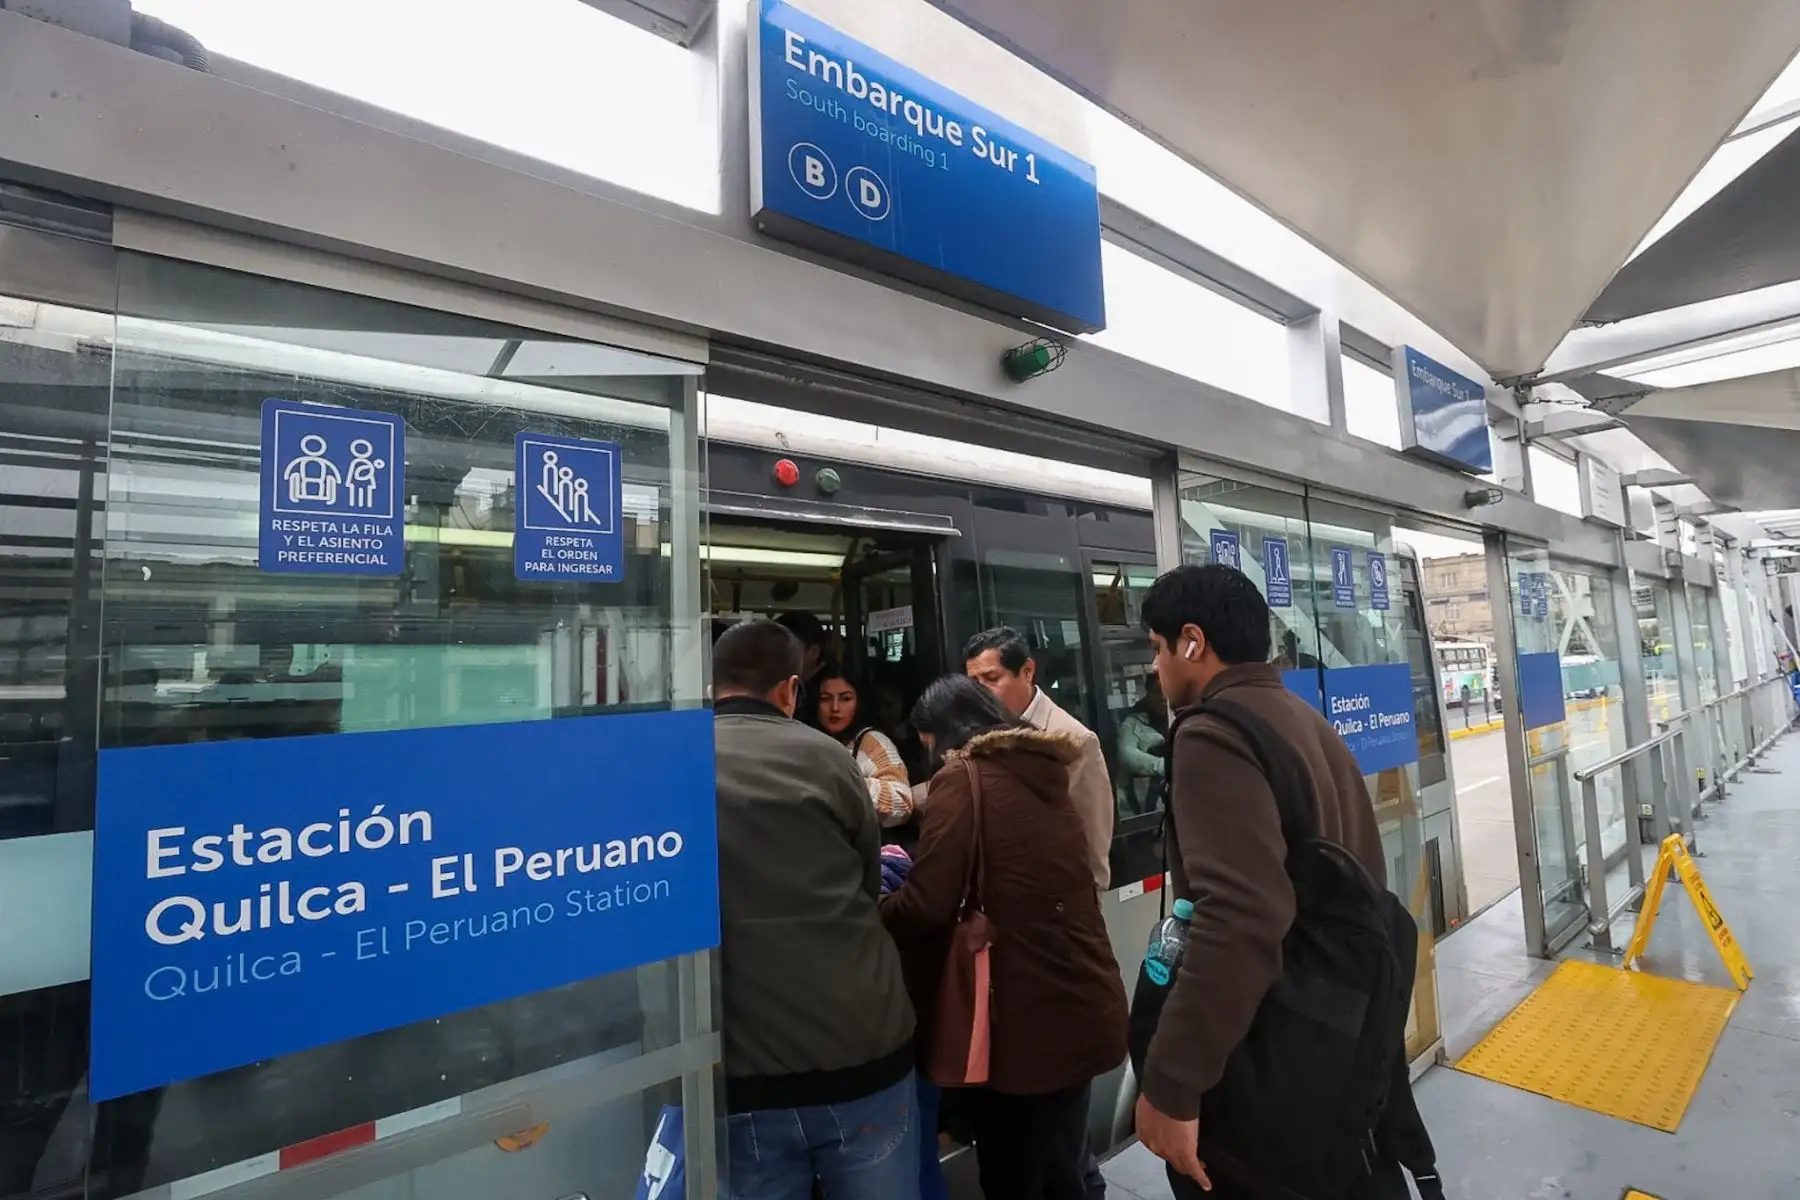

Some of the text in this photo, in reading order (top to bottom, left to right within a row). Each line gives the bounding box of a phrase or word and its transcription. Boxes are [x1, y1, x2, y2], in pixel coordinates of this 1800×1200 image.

[784, 29, 1040, 185] Embarque Sur 1
[786, 78, 950, 171] South boarding 1
[804, 155, 881, 209] B D
[272, 519, 393, 536] RESPETA LA FILA
[283, 534, 383, 550] Y EL ASIENTO
[545, 536, 594, 548] RESPETA
[278, 550, 388, 566] PREFERENCIAL
[541, 548, 598, 561] EL ORDEN
[524, 561, 613, 574] PARA INGRESAR
[1331, 693, 1370, 714] Estación
[1369, 714, 1378, 730] El
[1379, 712, 1410, 728] Peruano
[146, 804, 432, 879] Estación
[145, 880, 366, 945] Quilca
[432, 853, 477, 899] El
[495, 831, 683, 888] Peruano
[144, 951, 301, 1001] Quilca
[356, 926, 390, 960] El
[405, 902, 554, 950] Peruano
[566, 879, 670, 917] Station
